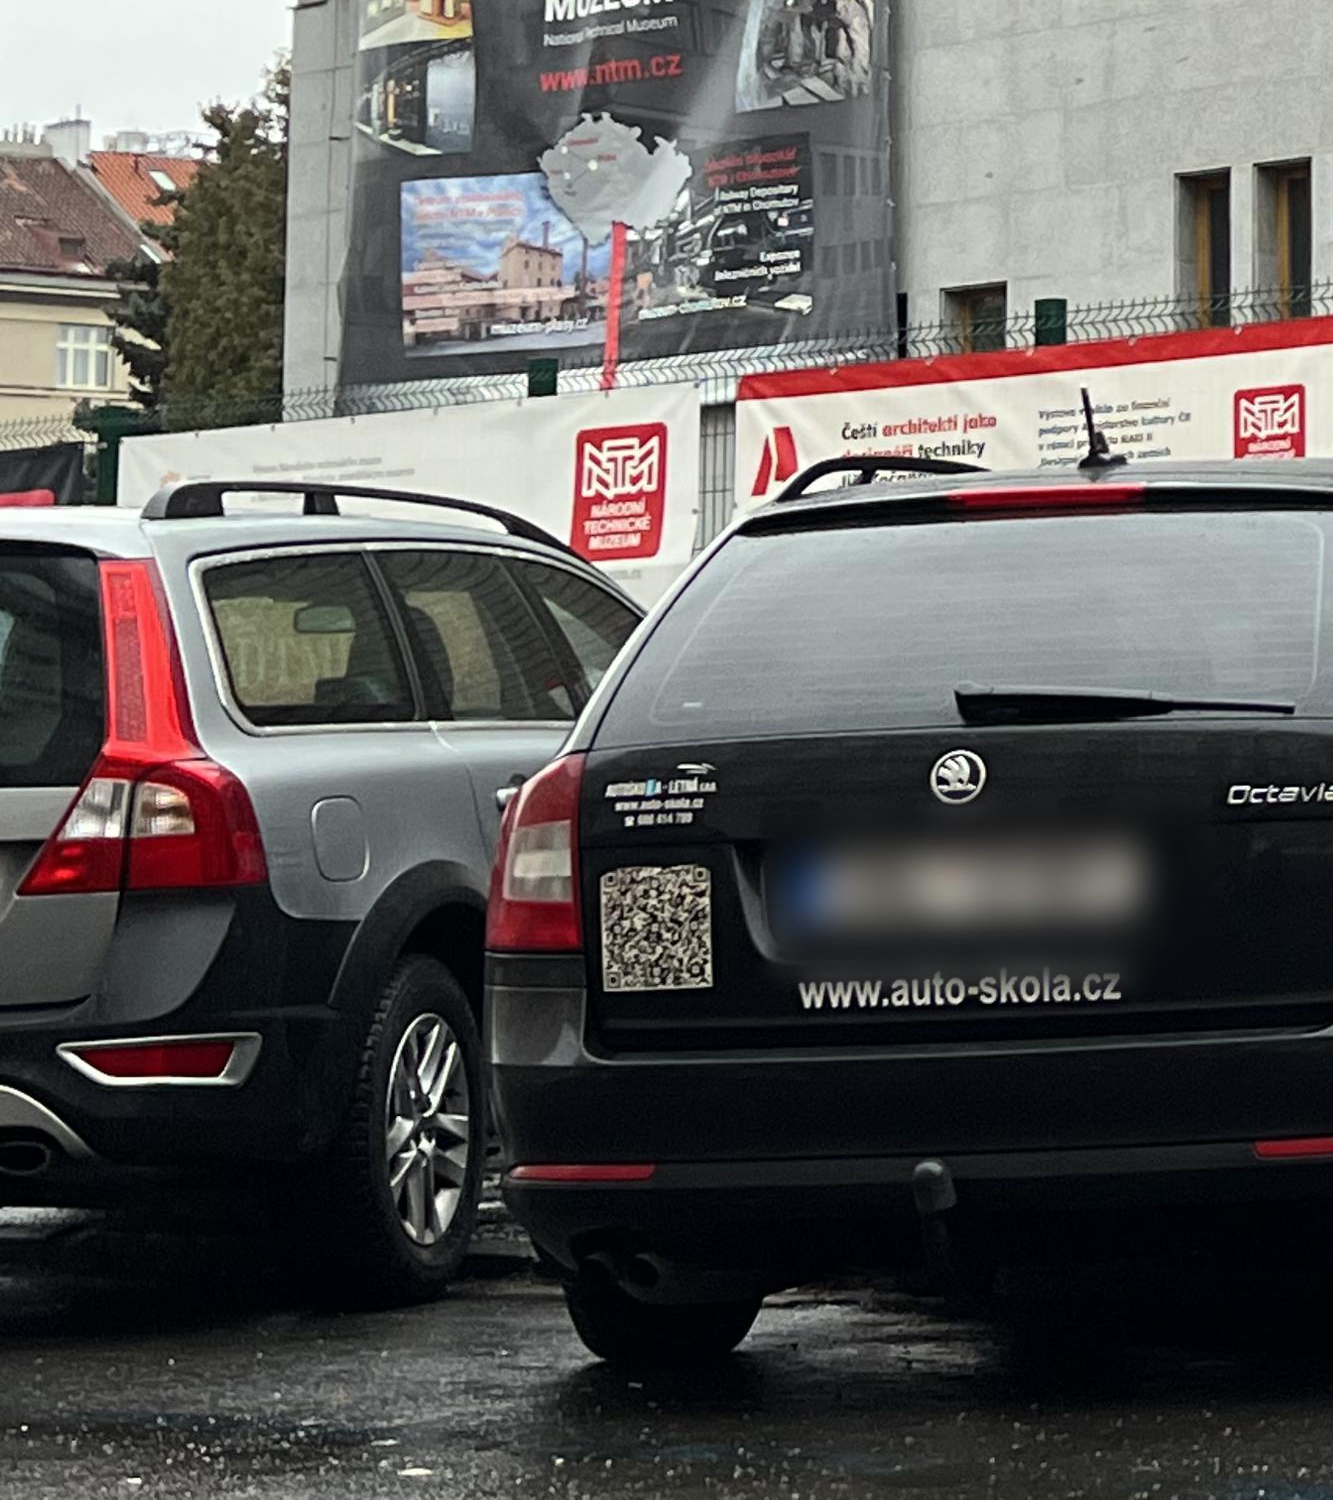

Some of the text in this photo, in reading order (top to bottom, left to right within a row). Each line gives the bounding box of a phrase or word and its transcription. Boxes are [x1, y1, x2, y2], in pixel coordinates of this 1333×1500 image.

[539, 52, 683, 93] www.ntm.cz
[841, 413, 998, 441] Čeští architekti jako
[918, 440, 986, 460] techniky
[798, 966, 1123, 1009] www.auto-skola.cz
